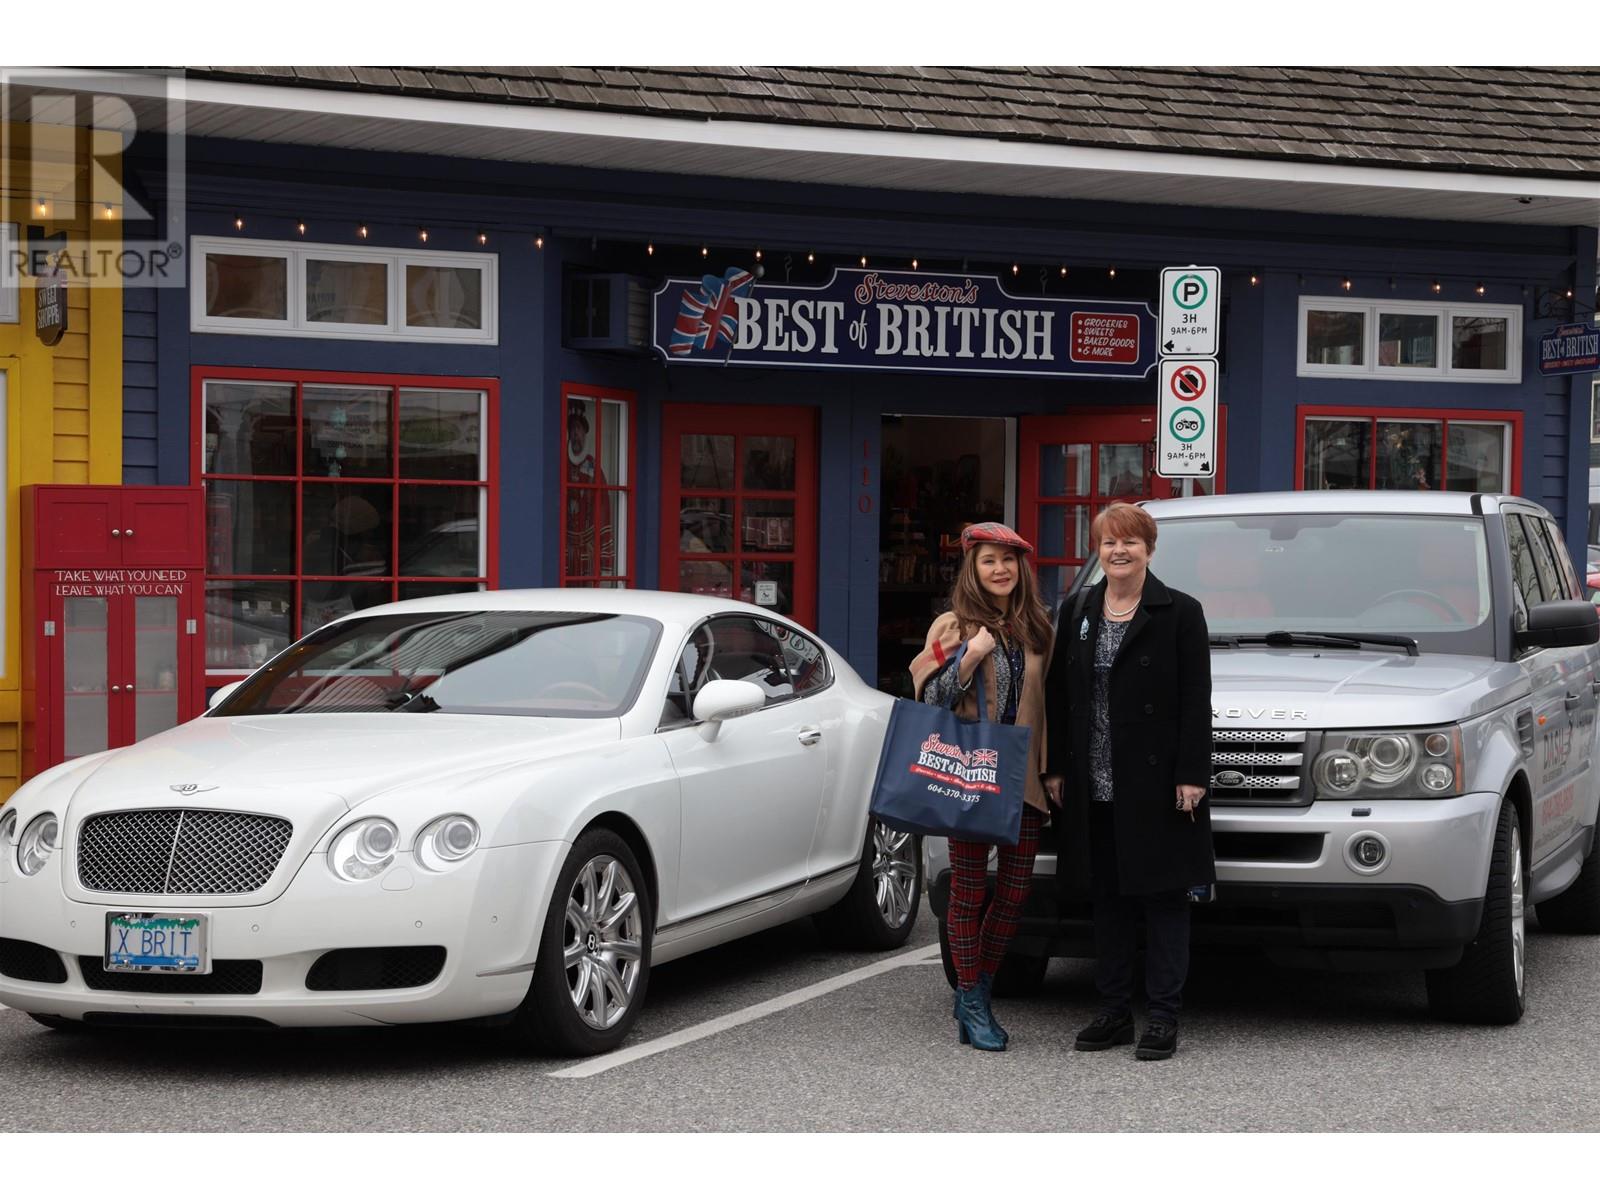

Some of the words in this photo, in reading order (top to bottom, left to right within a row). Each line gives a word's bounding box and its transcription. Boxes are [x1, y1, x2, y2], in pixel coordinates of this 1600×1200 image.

[855, 272, 979, 304] Steveston's
[1183, 282, 1200, 302] P
[1083, 318, 1128, 328] GROCERIES
[1182, 313, 1197, 324] 3H
[733, 296, 844, 353] BEST
[849, 309, 868, 350] of
[875, 303, 1056, 361] BRITISH
[1083, 327, 1115, 336] SWEETS
[1170, 326, 1208, 335] 9AM-6PM
[1083, 336, 1109, 346] BAKED
[1109, 338, 1136, 348] GOODS
[1566, 334, 1598, 357] BRITISH
[1091, 347, 1115, 356] MORE
[1181, 443, 1193, 451] 3H
[1167, 452, 1206, 461] 9AM-6PM
[54, 570, 91, 581] TAKE
[93, 570, 126, 581] WHAT
[127, 570, 152, 581] YOU
[152, 570, 187, 581] NEED
[56, 585, 93, 596] LEAVE
[94, 585, 126, 595] WHAT
[128, 585, 152, 595] YOU
[155, 585, 183, 595] CAN
[917, 751, 950, 773] BEST
[954, 761, 997, 784] BRITISH
[118, 929, 129, 953] X
[142, 930, 192, 955] BRIT
